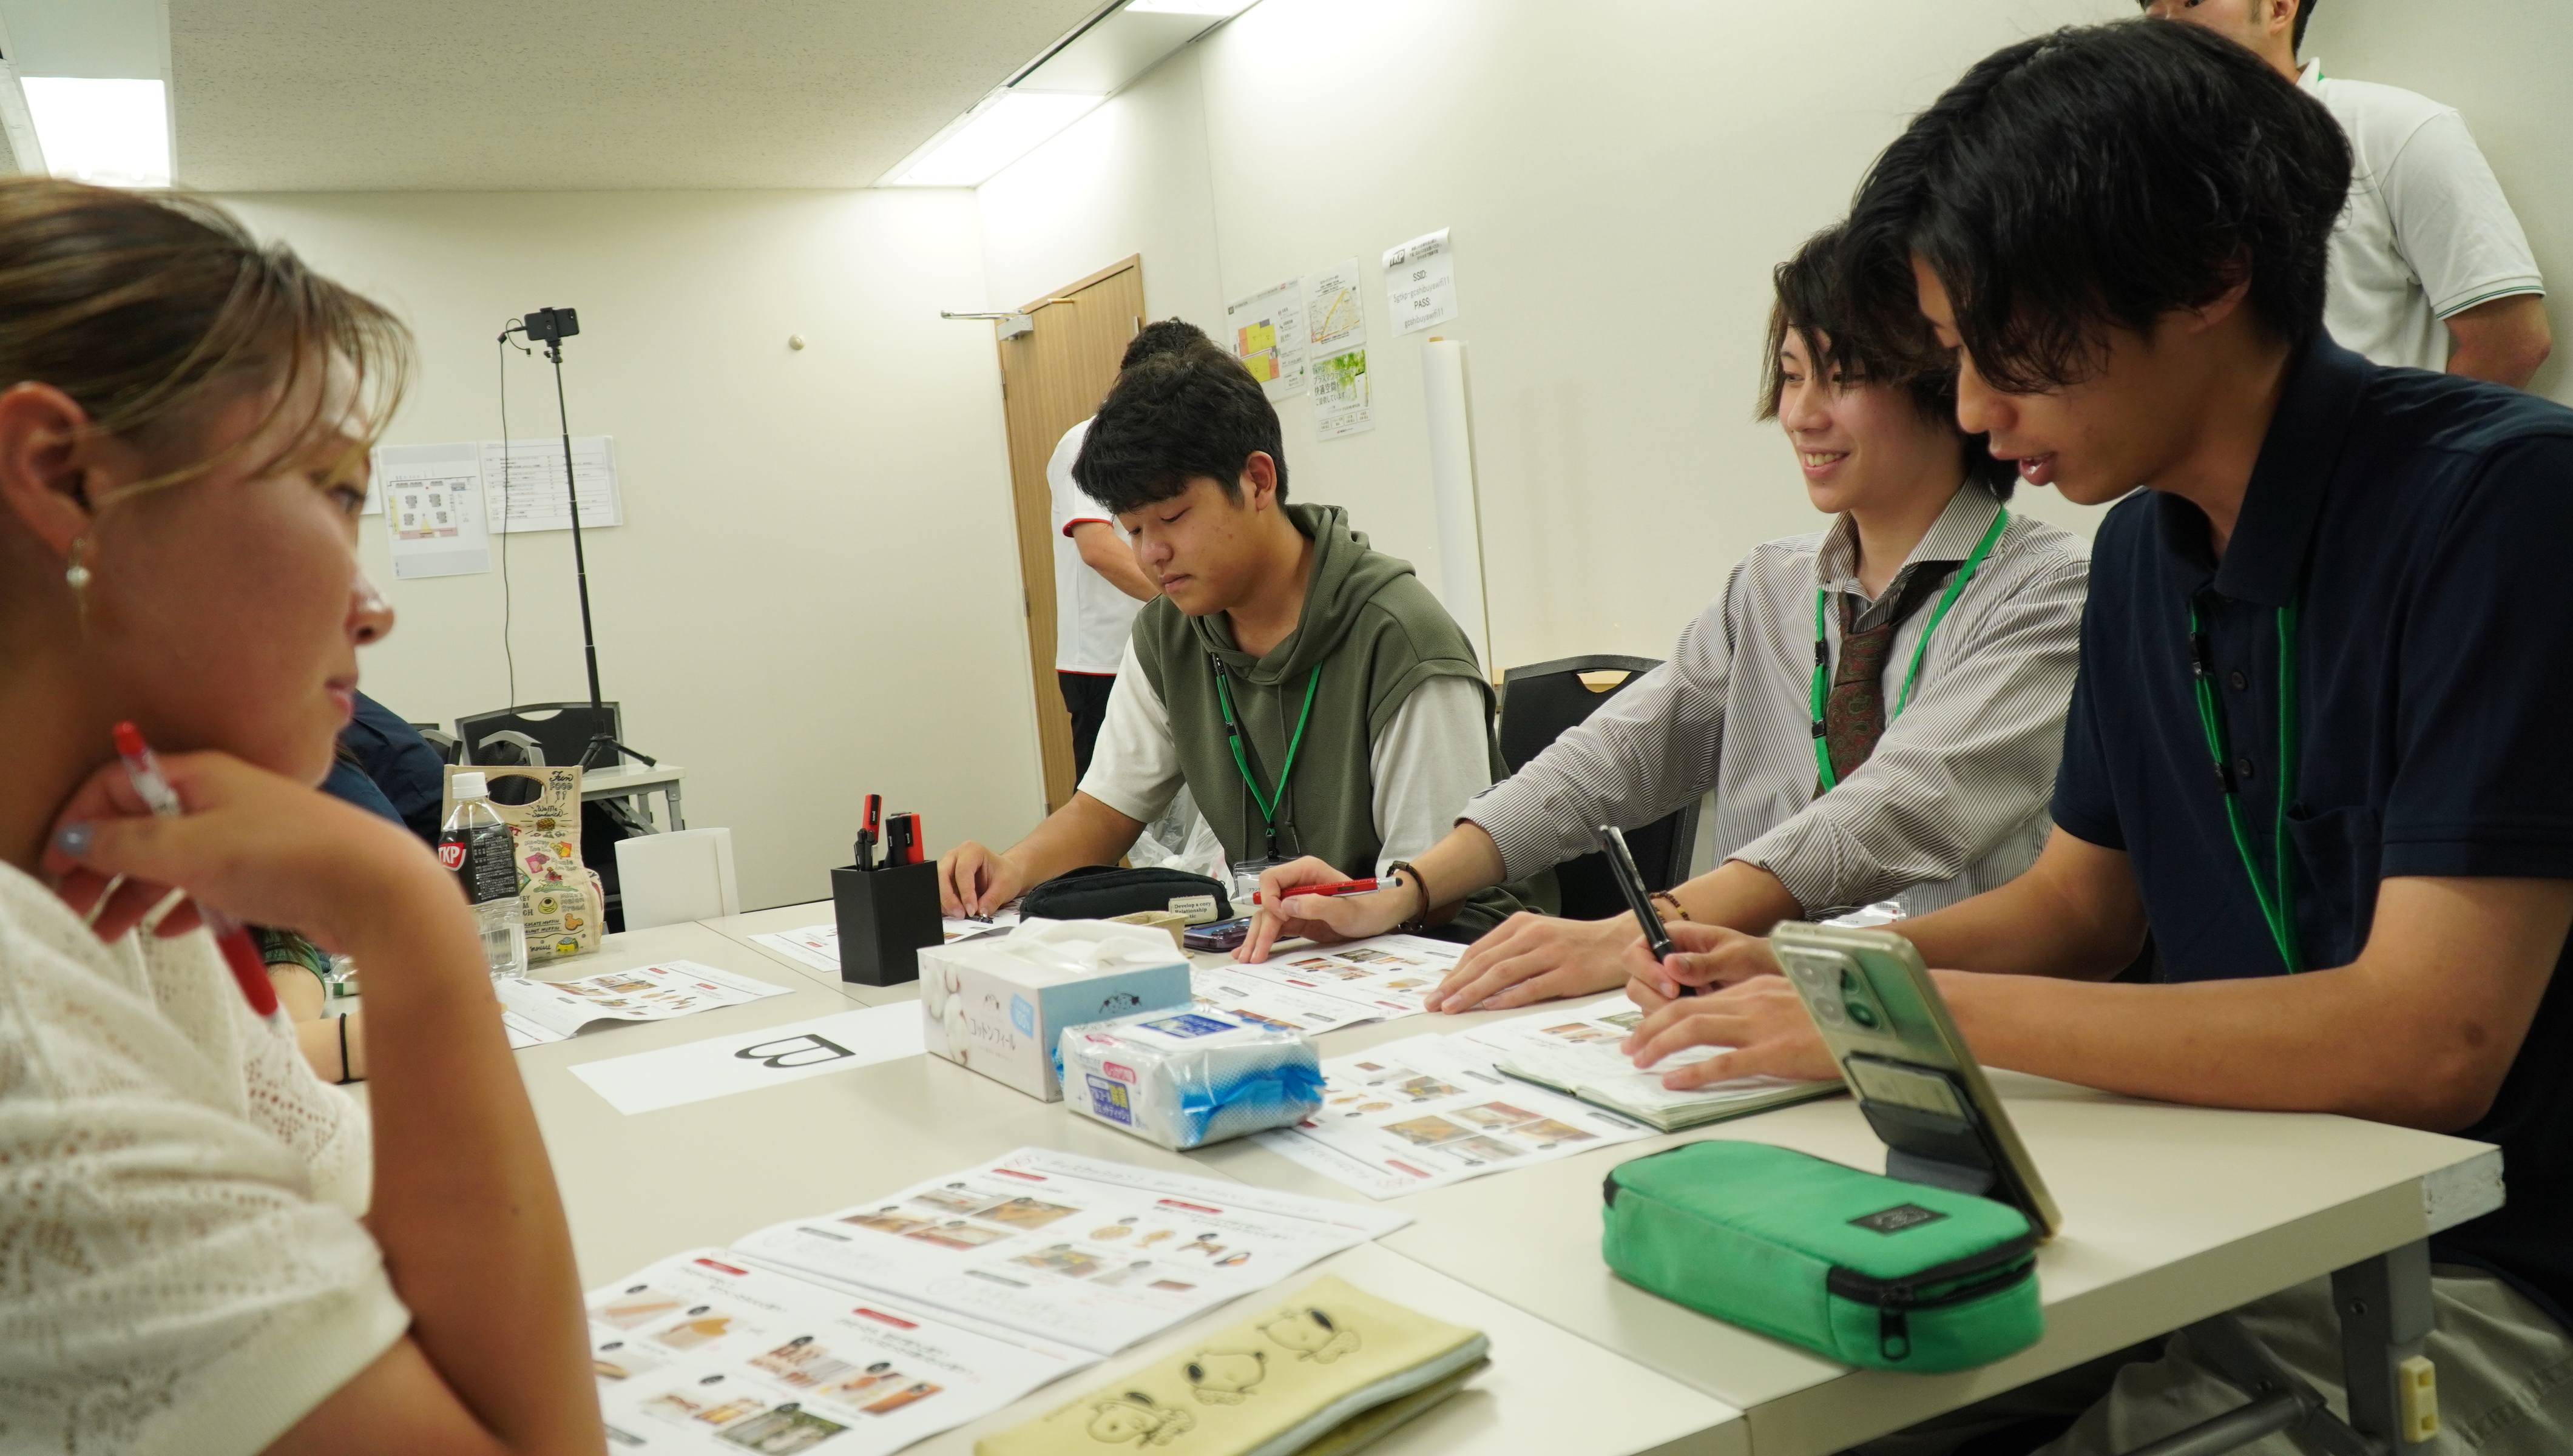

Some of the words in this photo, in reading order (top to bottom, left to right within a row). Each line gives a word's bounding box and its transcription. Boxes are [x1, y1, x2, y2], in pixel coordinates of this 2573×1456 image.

[1390, 250, 1404, 265] TKP
[1413, 270, 1427, 281] SSID:
[1415, 297, 1431, 310] PASS:
[1314, 381, 1340, 396] 快適空間を
[549, 770, 573, 782] Fun
[532, 809, 564, 818] Sandwich
[439, 846, 460, 864] TKP
[970, 1019, 1016, 1050] コットンフィール
[734, 1034, 856, 1068] B
